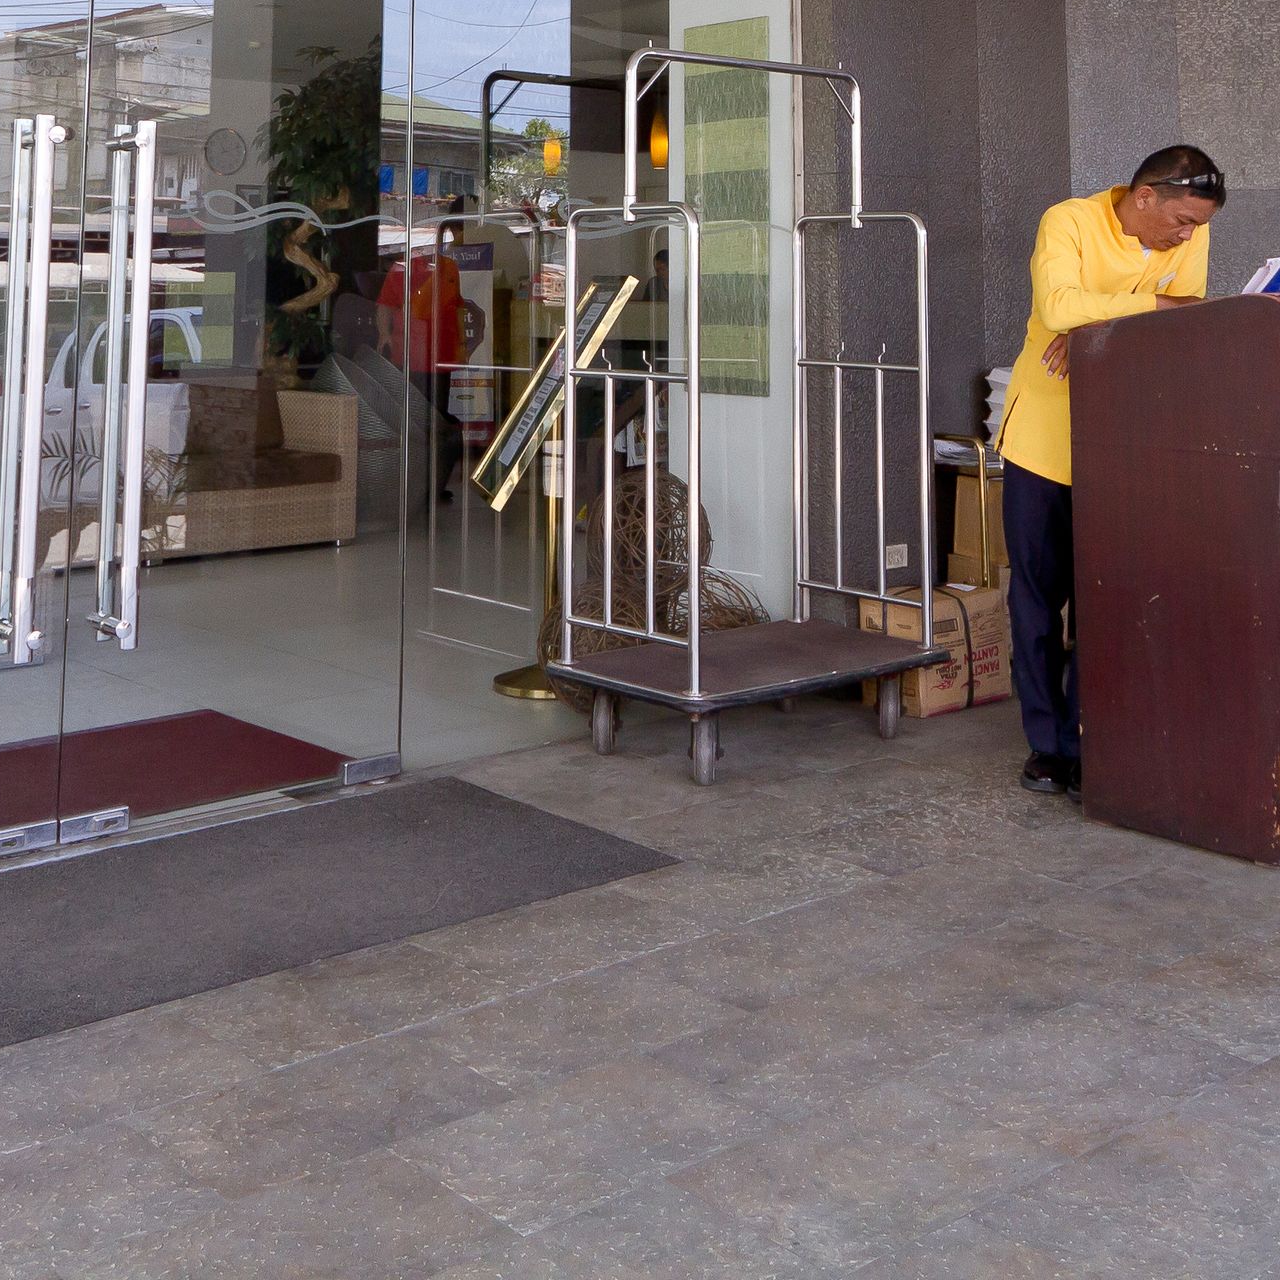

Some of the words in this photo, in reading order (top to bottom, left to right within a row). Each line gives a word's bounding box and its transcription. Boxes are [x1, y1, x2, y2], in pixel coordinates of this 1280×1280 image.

[460, 251, 481, 261] You!
[964, 645, 1000, 665] CANTON
[971, 659, 1000, 677] PANCI
